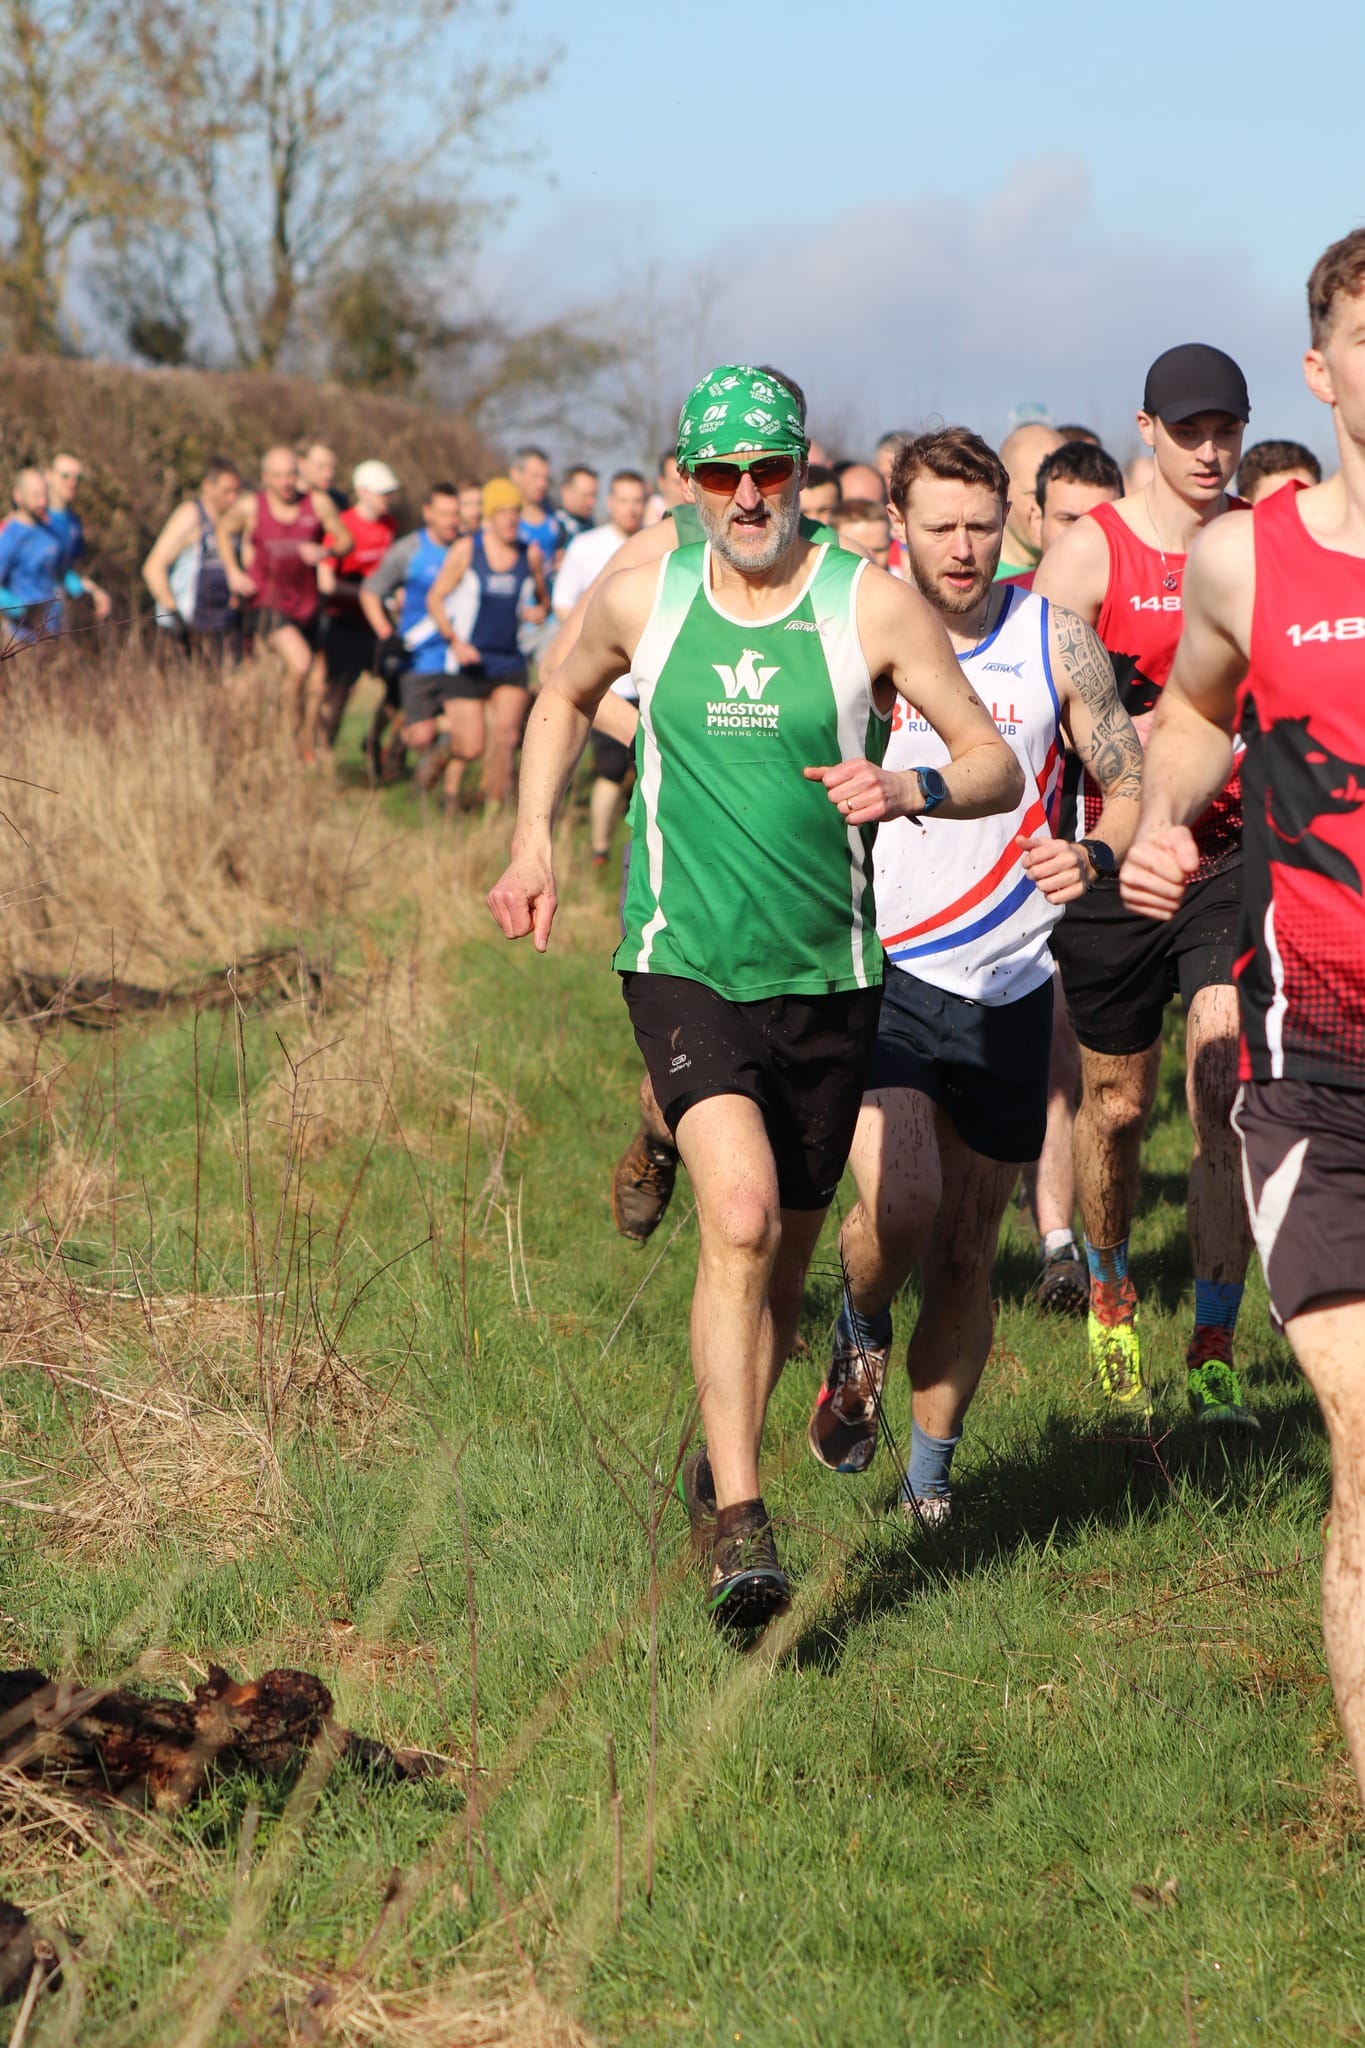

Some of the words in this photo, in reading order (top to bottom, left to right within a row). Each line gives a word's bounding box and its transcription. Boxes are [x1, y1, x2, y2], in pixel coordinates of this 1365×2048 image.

[1129, 595, 1184, 612] 148
[706, 702, 779, 716] WIGSTON
[706, 715, 779, 729] PHOENIX
[757, 730, 780, 738] CLUB
